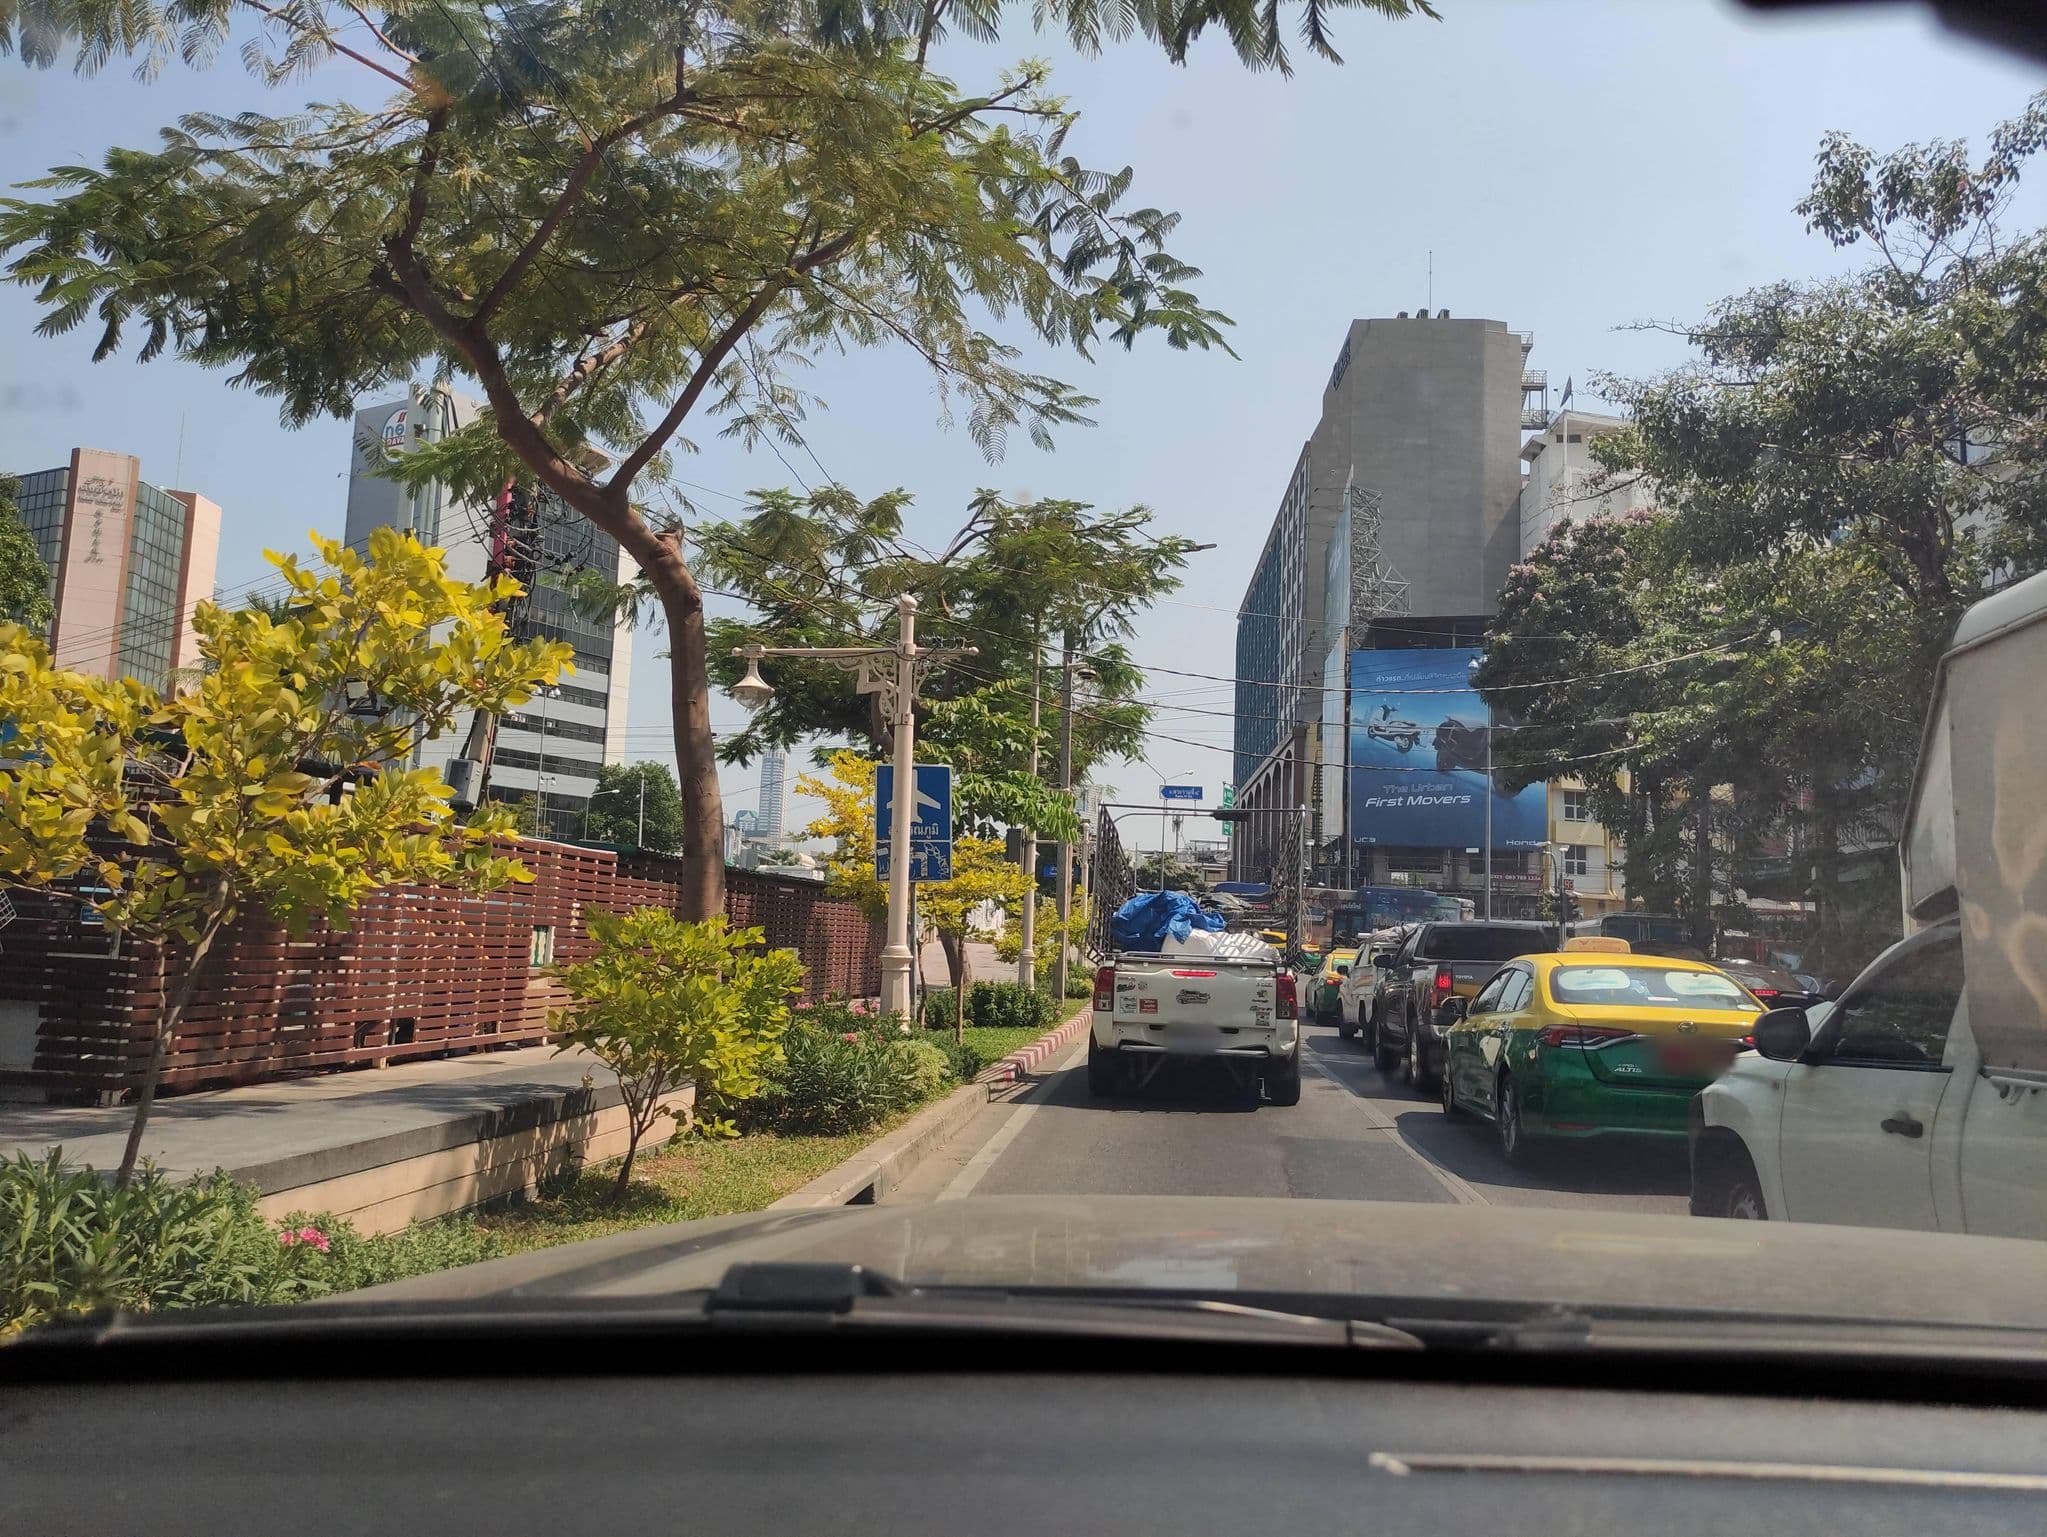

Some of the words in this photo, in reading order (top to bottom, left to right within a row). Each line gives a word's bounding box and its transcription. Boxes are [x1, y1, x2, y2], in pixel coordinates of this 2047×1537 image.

[1383, 784, 1408, 794] The
[1411, 783, 1453, 793] Urban
[1365, 796, 1404, 808] First
[1407, 794, 1471, 806] Movers
